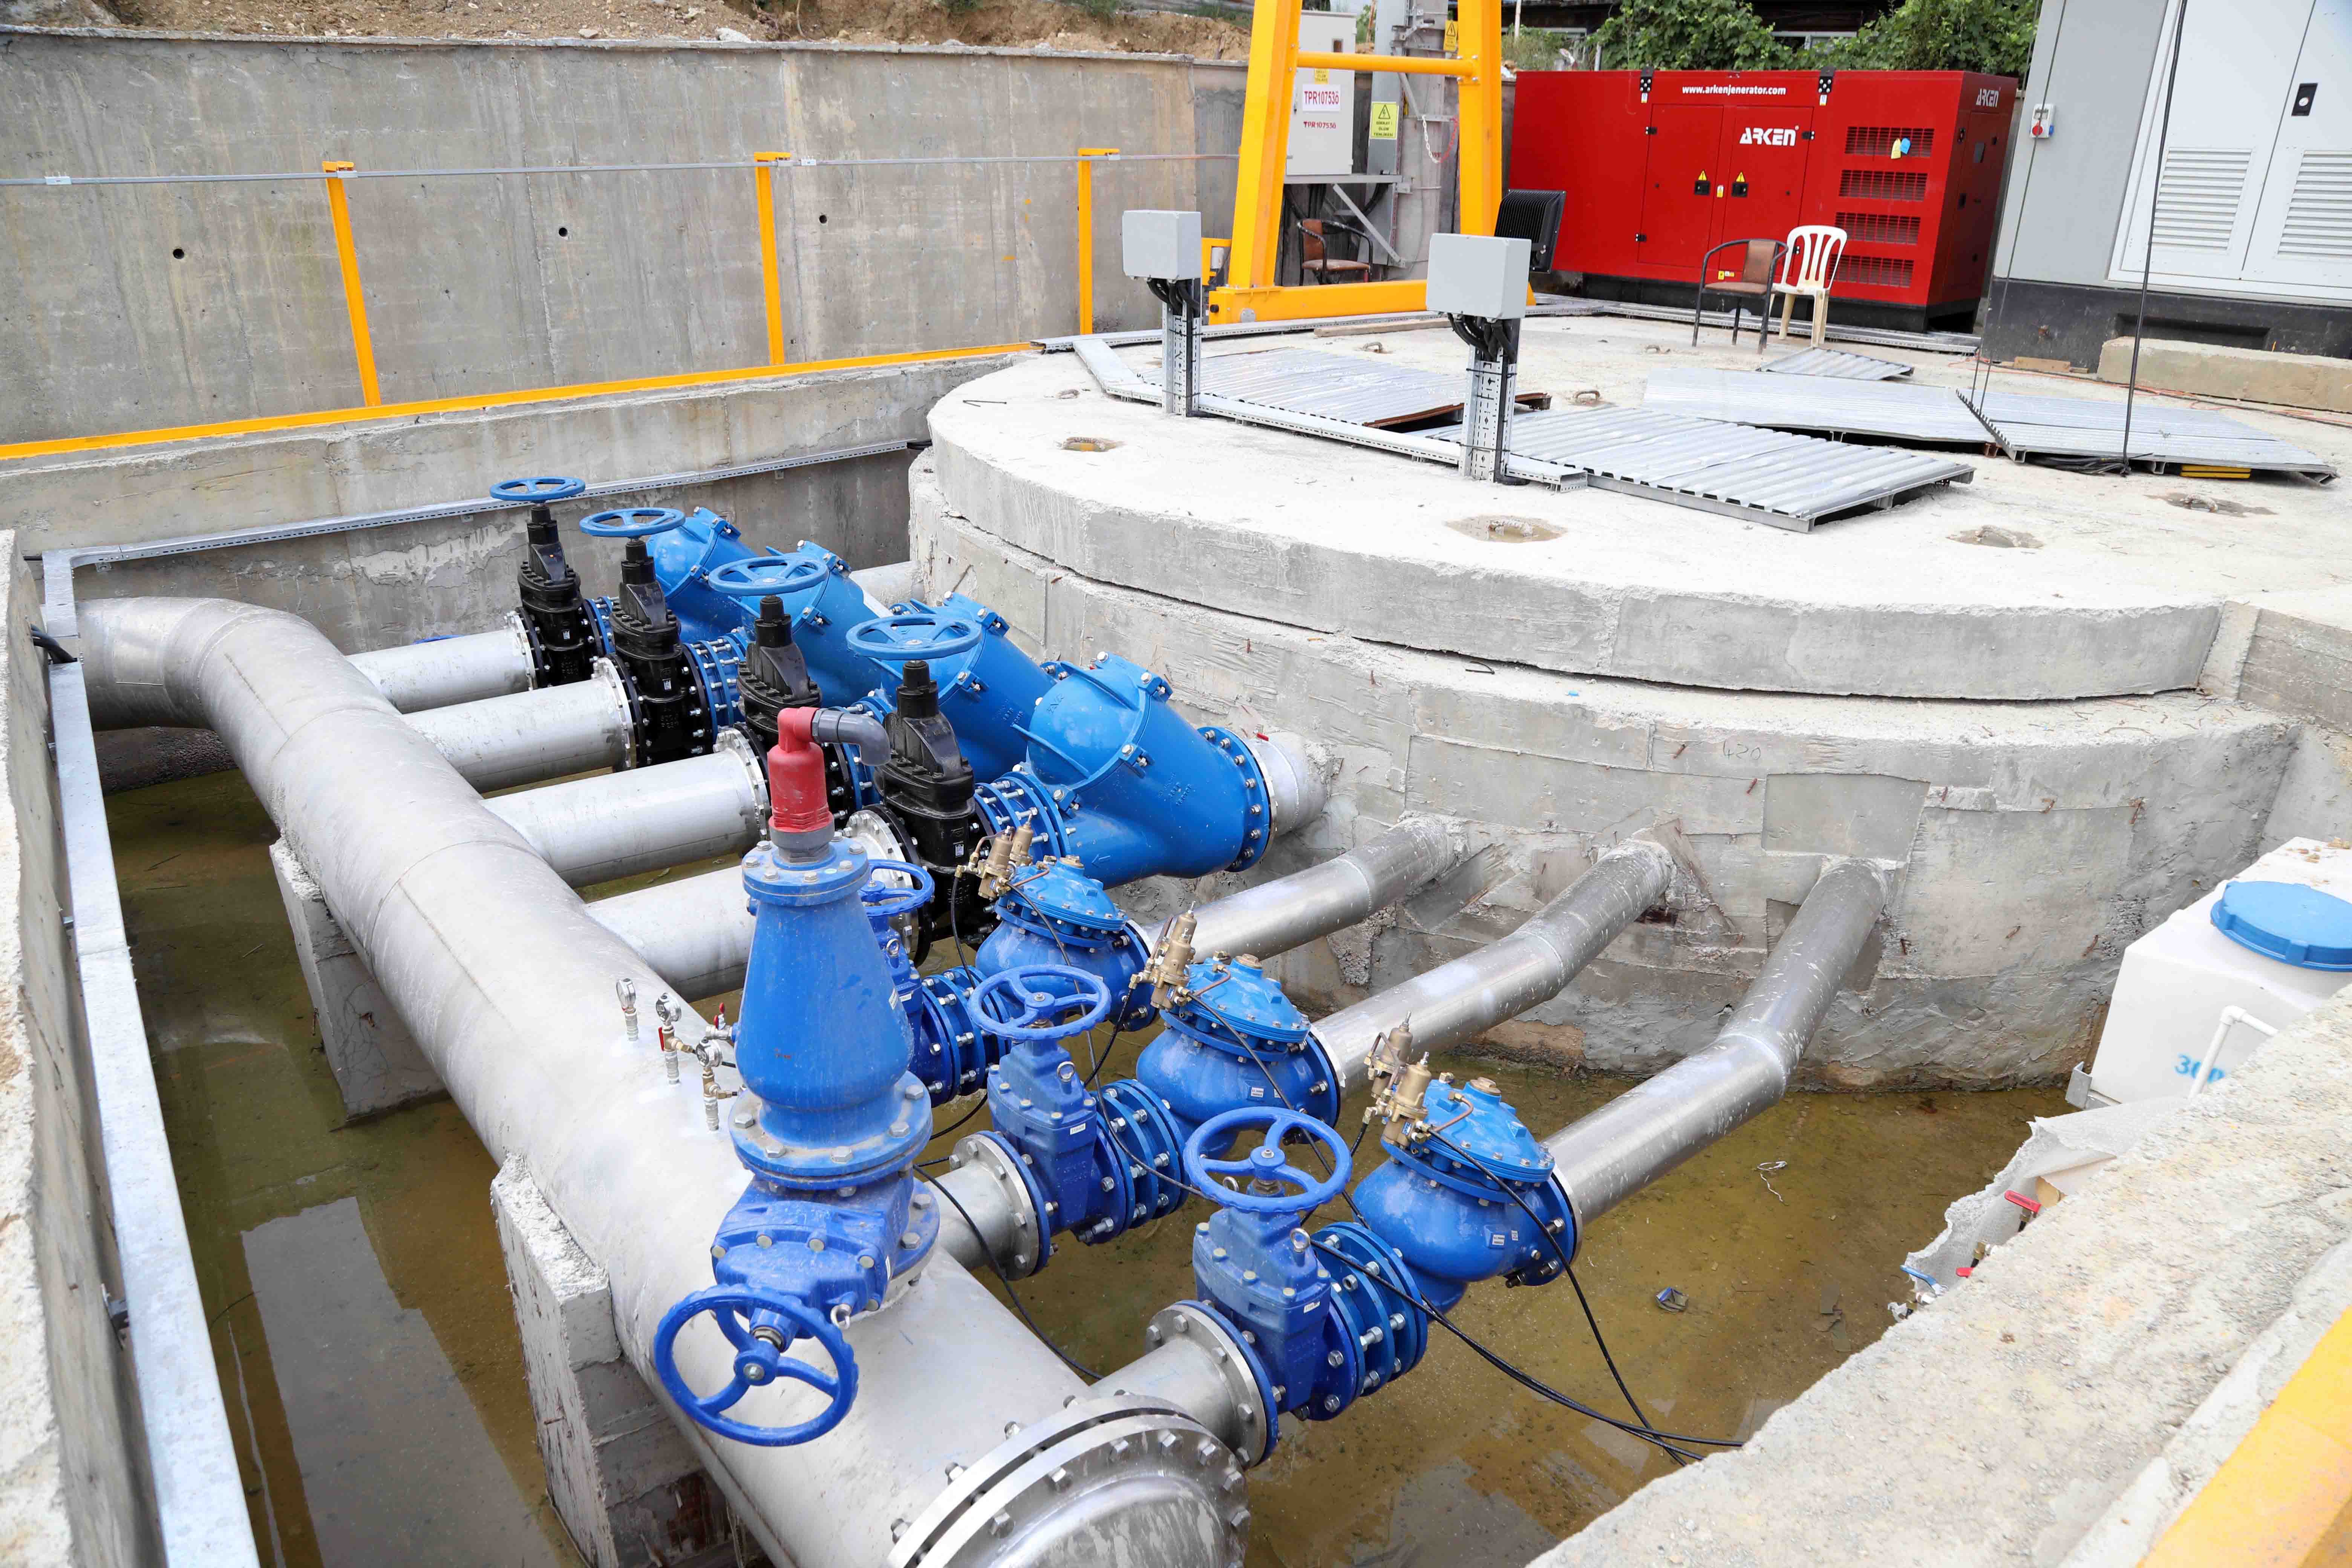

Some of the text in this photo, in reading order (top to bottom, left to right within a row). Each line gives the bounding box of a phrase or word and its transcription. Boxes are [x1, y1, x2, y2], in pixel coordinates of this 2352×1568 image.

[1682, 84, 1786, 95] www.arkenjenerator.com
[1976, 88, 1999, 107] ARKEN
[1740, 127, 1796, 146] ARKEN
[1723, 740, 1761, 760] 420
